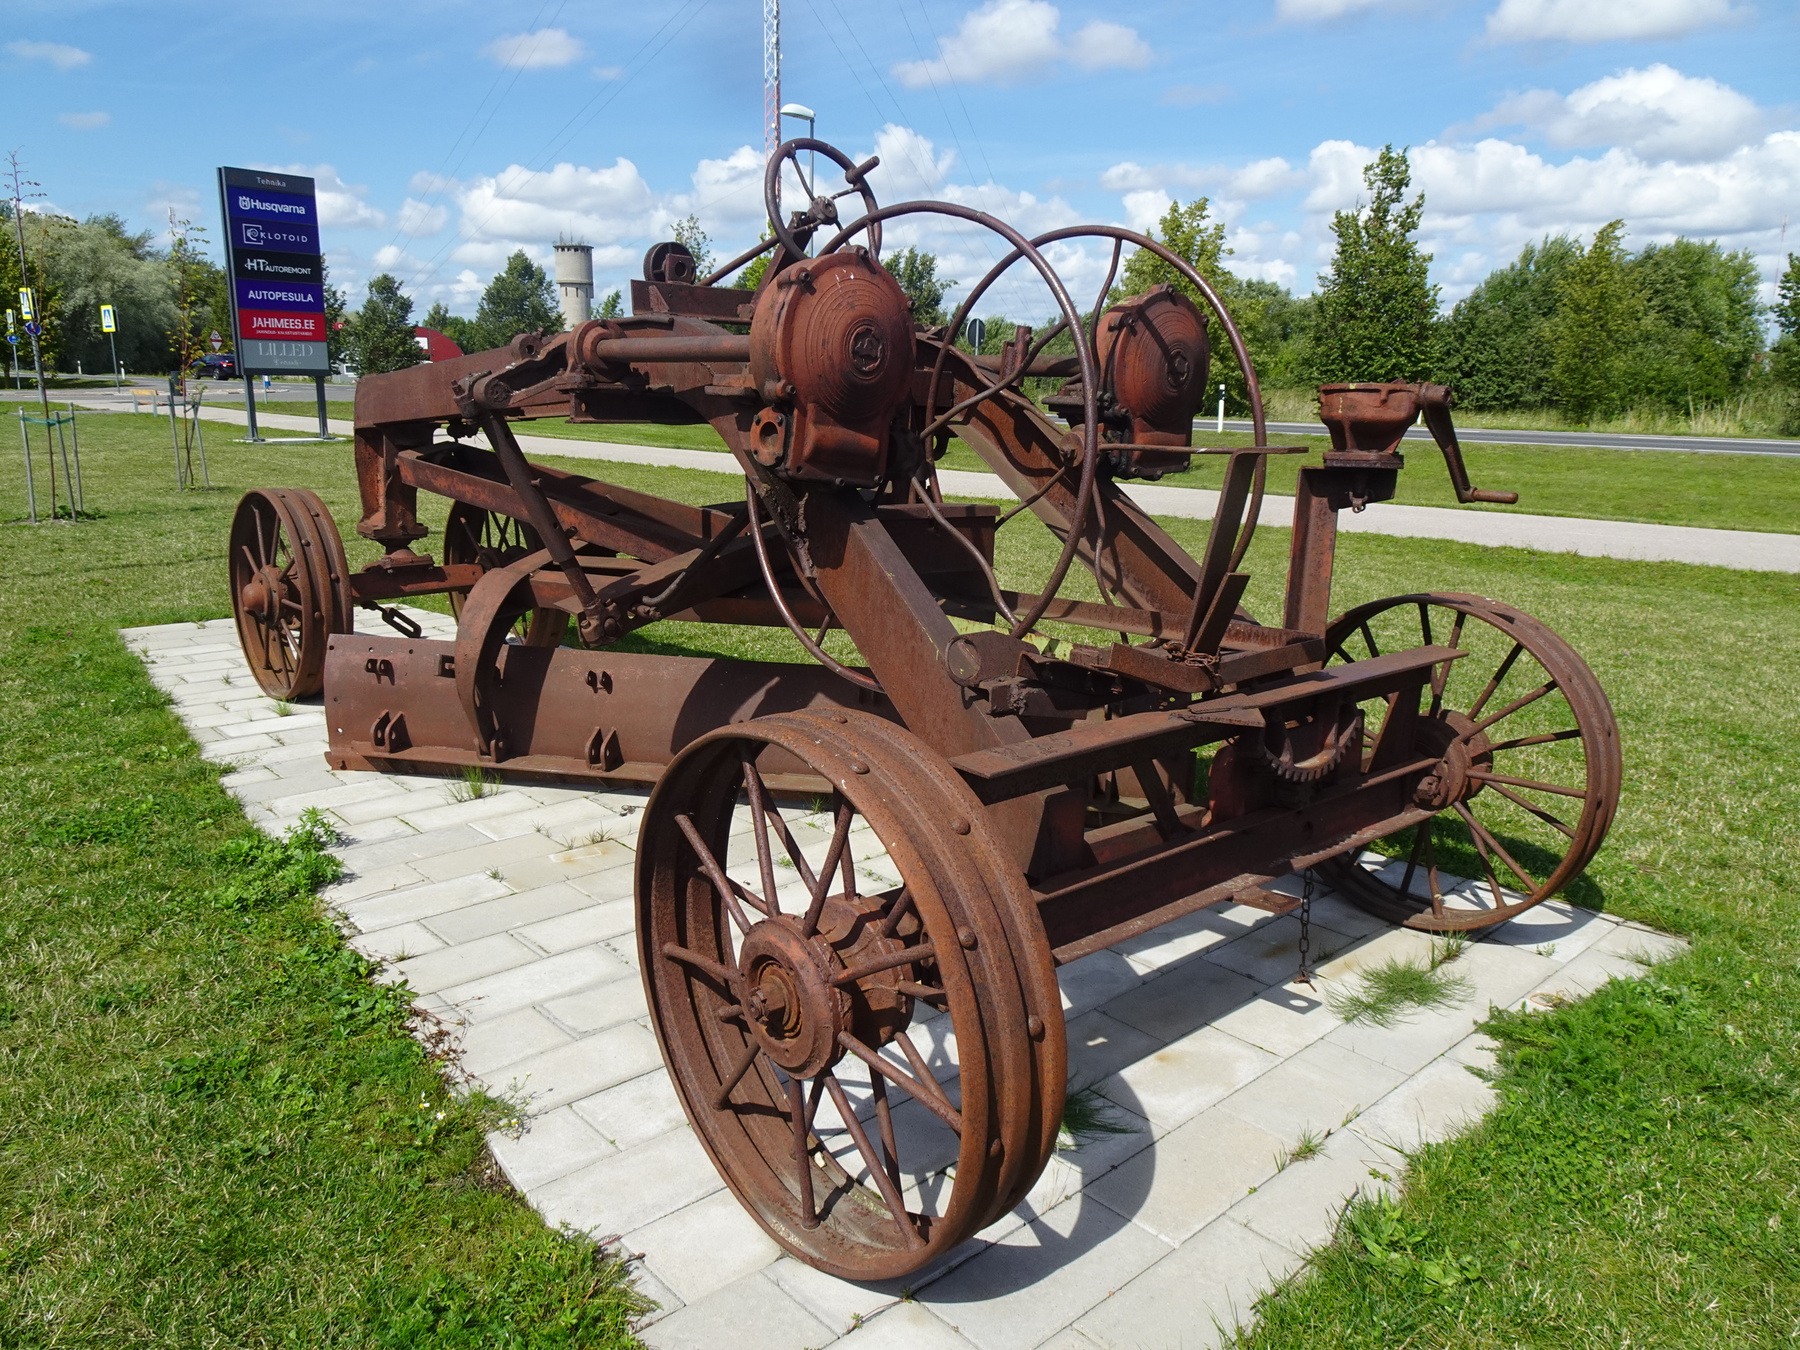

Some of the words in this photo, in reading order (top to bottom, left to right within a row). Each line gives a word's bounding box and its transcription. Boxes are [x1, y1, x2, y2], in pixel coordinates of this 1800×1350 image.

[256, 176, 287, 187] Tehnika
[250, 198, 306, 215] Husqvarna
[260, 232, 308, 243] KLOTOID
[246, 258, 266, 272] HT
[265, 265, 312, 275] AUTOREMONT
[248, 290, 314, 303] AUTOPESULA
[252, 317, 315, 330] JAHIMEES.EE
[258, 342, 314, 357] LILLED
